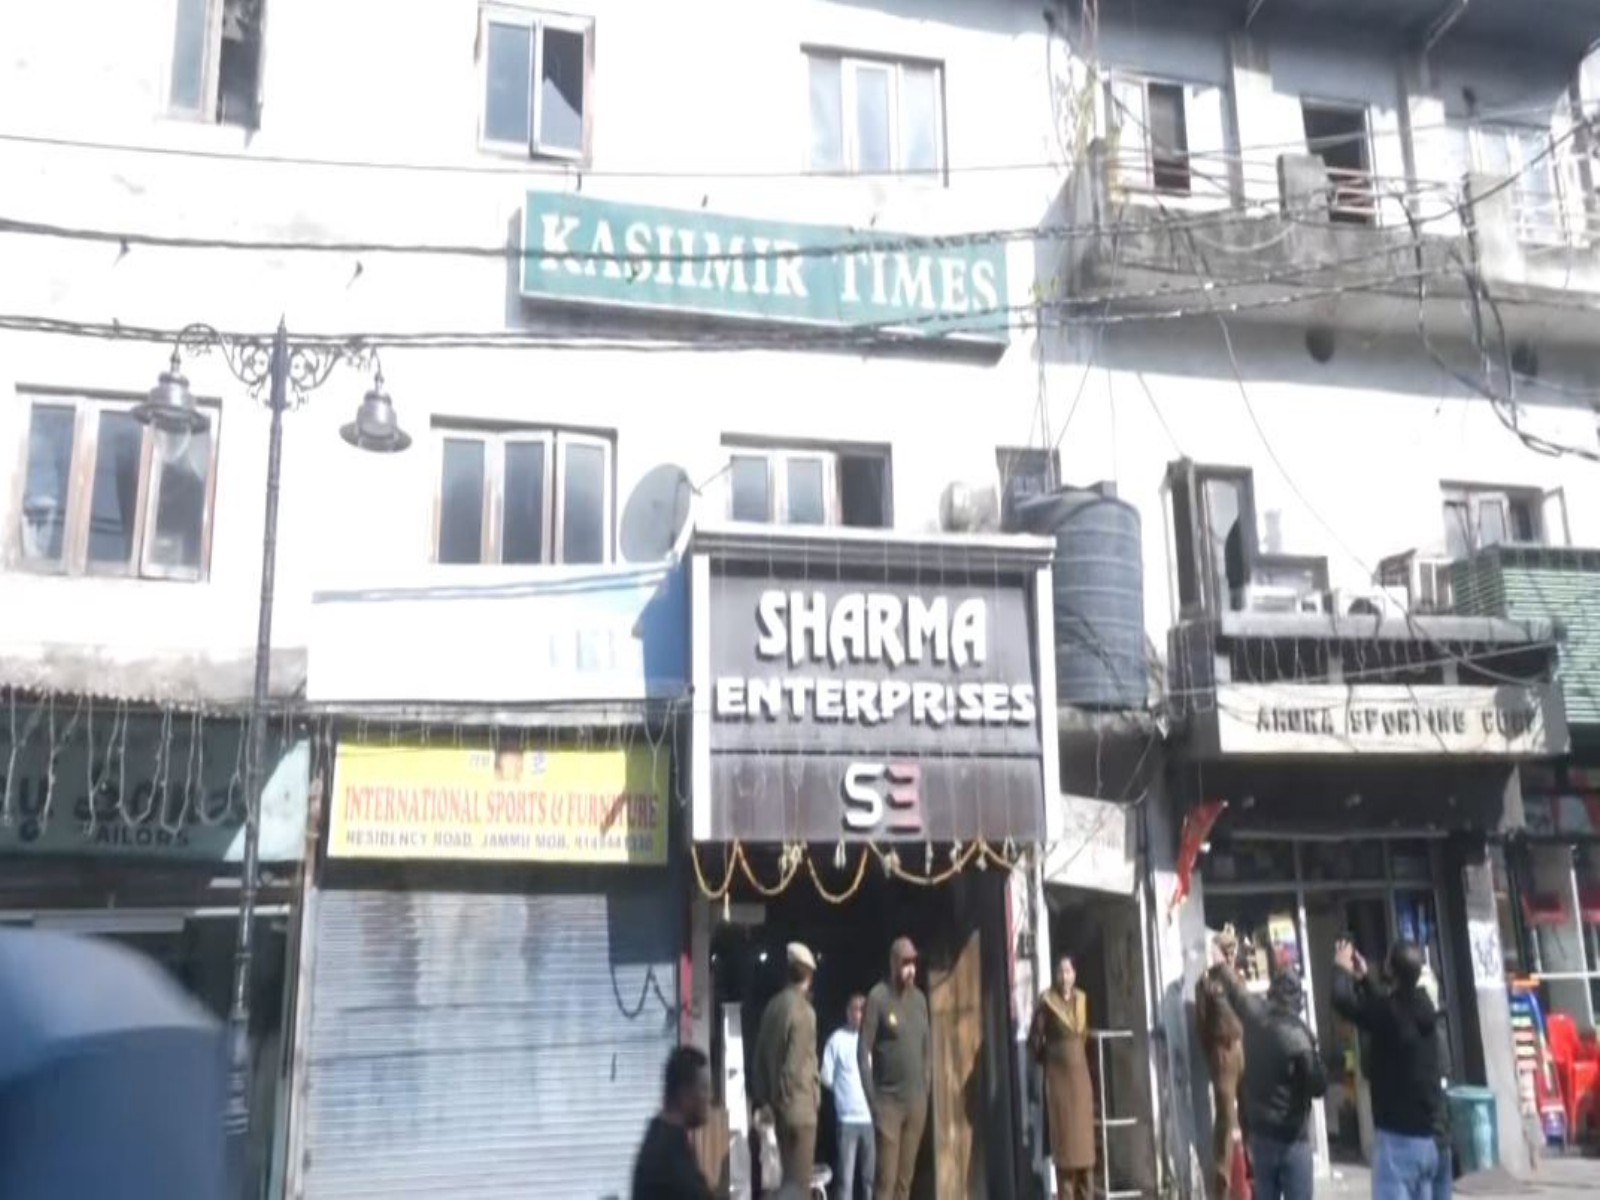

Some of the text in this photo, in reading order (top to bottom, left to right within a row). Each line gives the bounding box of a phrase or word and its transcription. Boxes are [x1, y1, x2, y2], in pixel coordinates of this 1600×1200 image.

[540, 212, 999, 312] KASHMIR TIMES
[757, 590, 987, 669] SHARMA
[714, 676, 1036, 724] ENTERPRISES
[344, 785, 483, 825] INTERNATIONAL
[486, 789, 547, 827] SPORTS
[568, 789, 659, 829] FURNITURE
[346, 829, 427, 847] RESIDENCY
[480, 832, 531, 850] JAMMU
